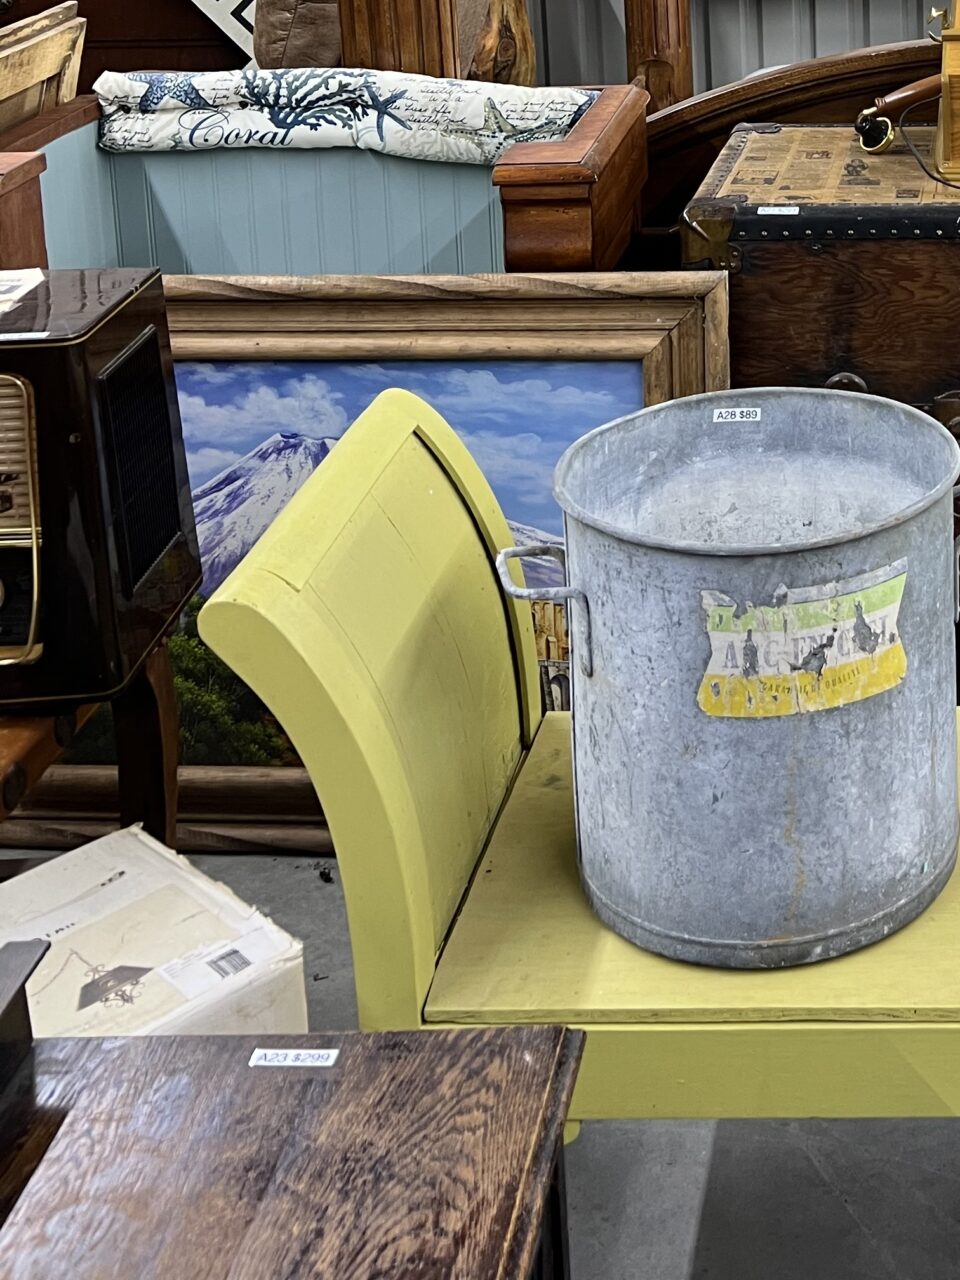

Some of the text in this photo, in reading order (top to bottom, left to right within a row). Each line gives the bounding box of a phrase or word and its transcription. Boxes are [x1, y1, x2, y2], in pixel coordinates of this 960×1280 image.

[178, 108, 294, 149] Coral
[716, 409, 758, 421] A28 $89
[256, 1052, 331, 1064] A23 $299
